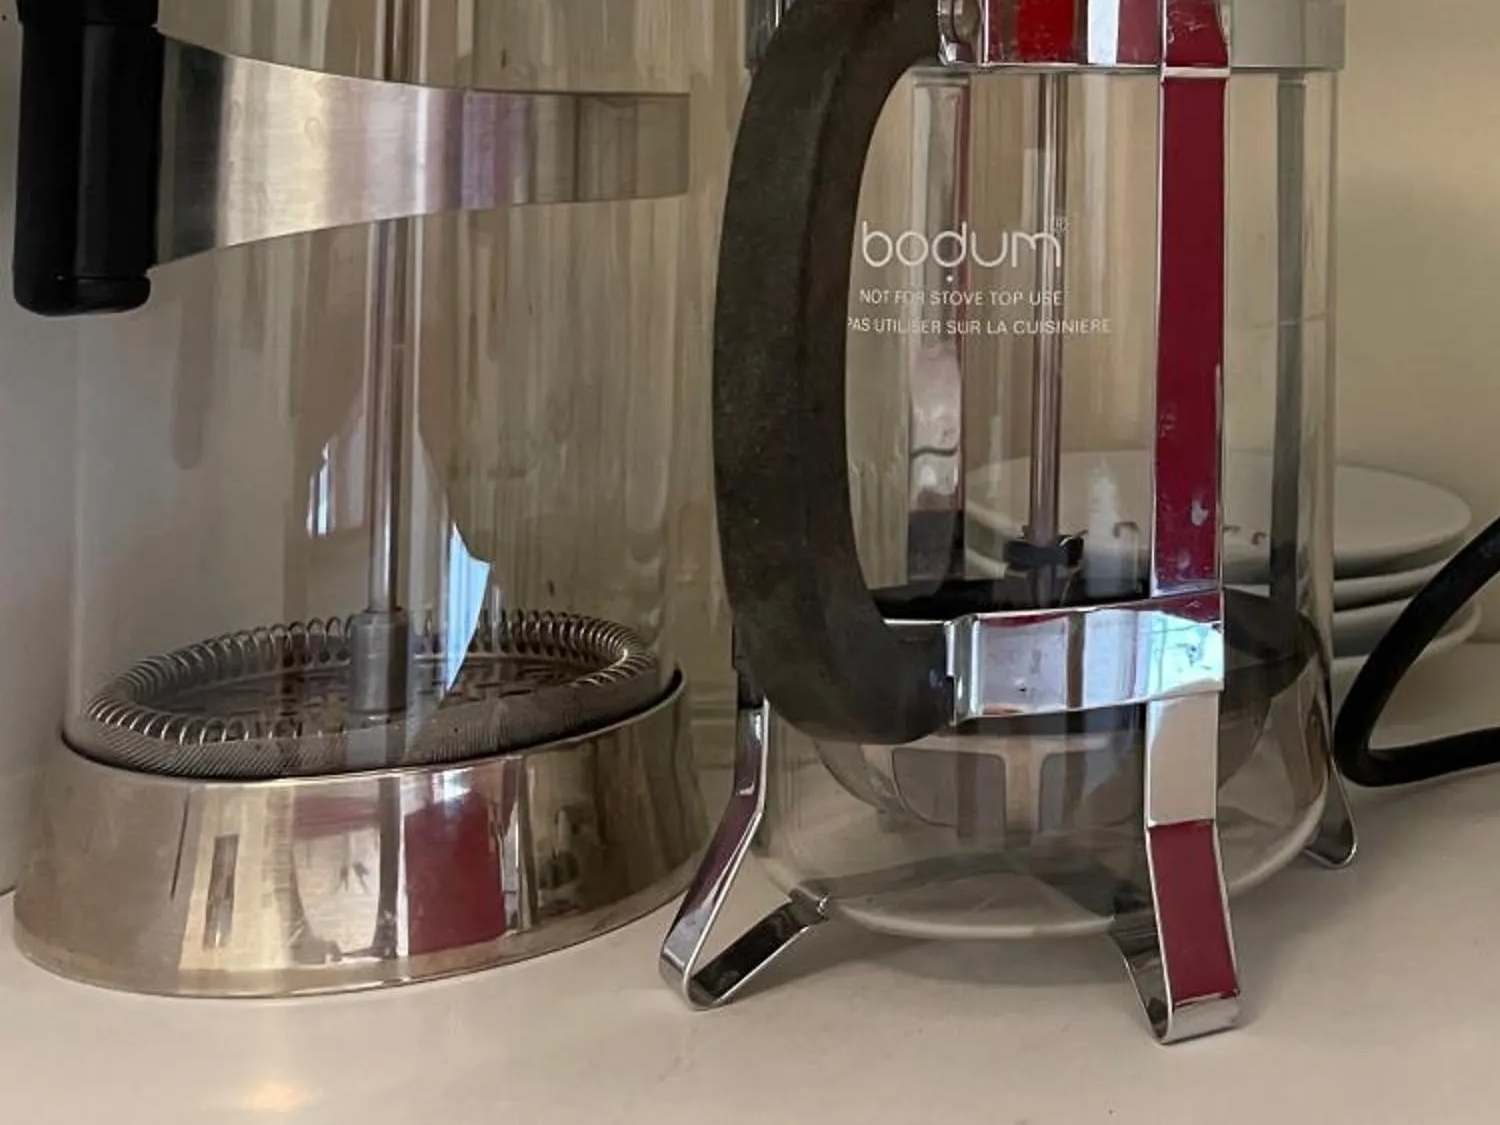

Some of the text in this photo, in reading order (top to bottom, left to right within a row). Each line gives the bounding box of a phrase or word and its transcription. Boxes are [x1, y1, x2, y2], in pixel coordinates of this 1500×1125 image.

[861, 220, 1062, 282] bodum
[859, 289, 1064, 307] NOT FOR STOVE TOP USE
[874, 318, 942, 335] UTILISER
[945, 320, 981, 335] SUR
[987, 320, 1008, 335] LA
